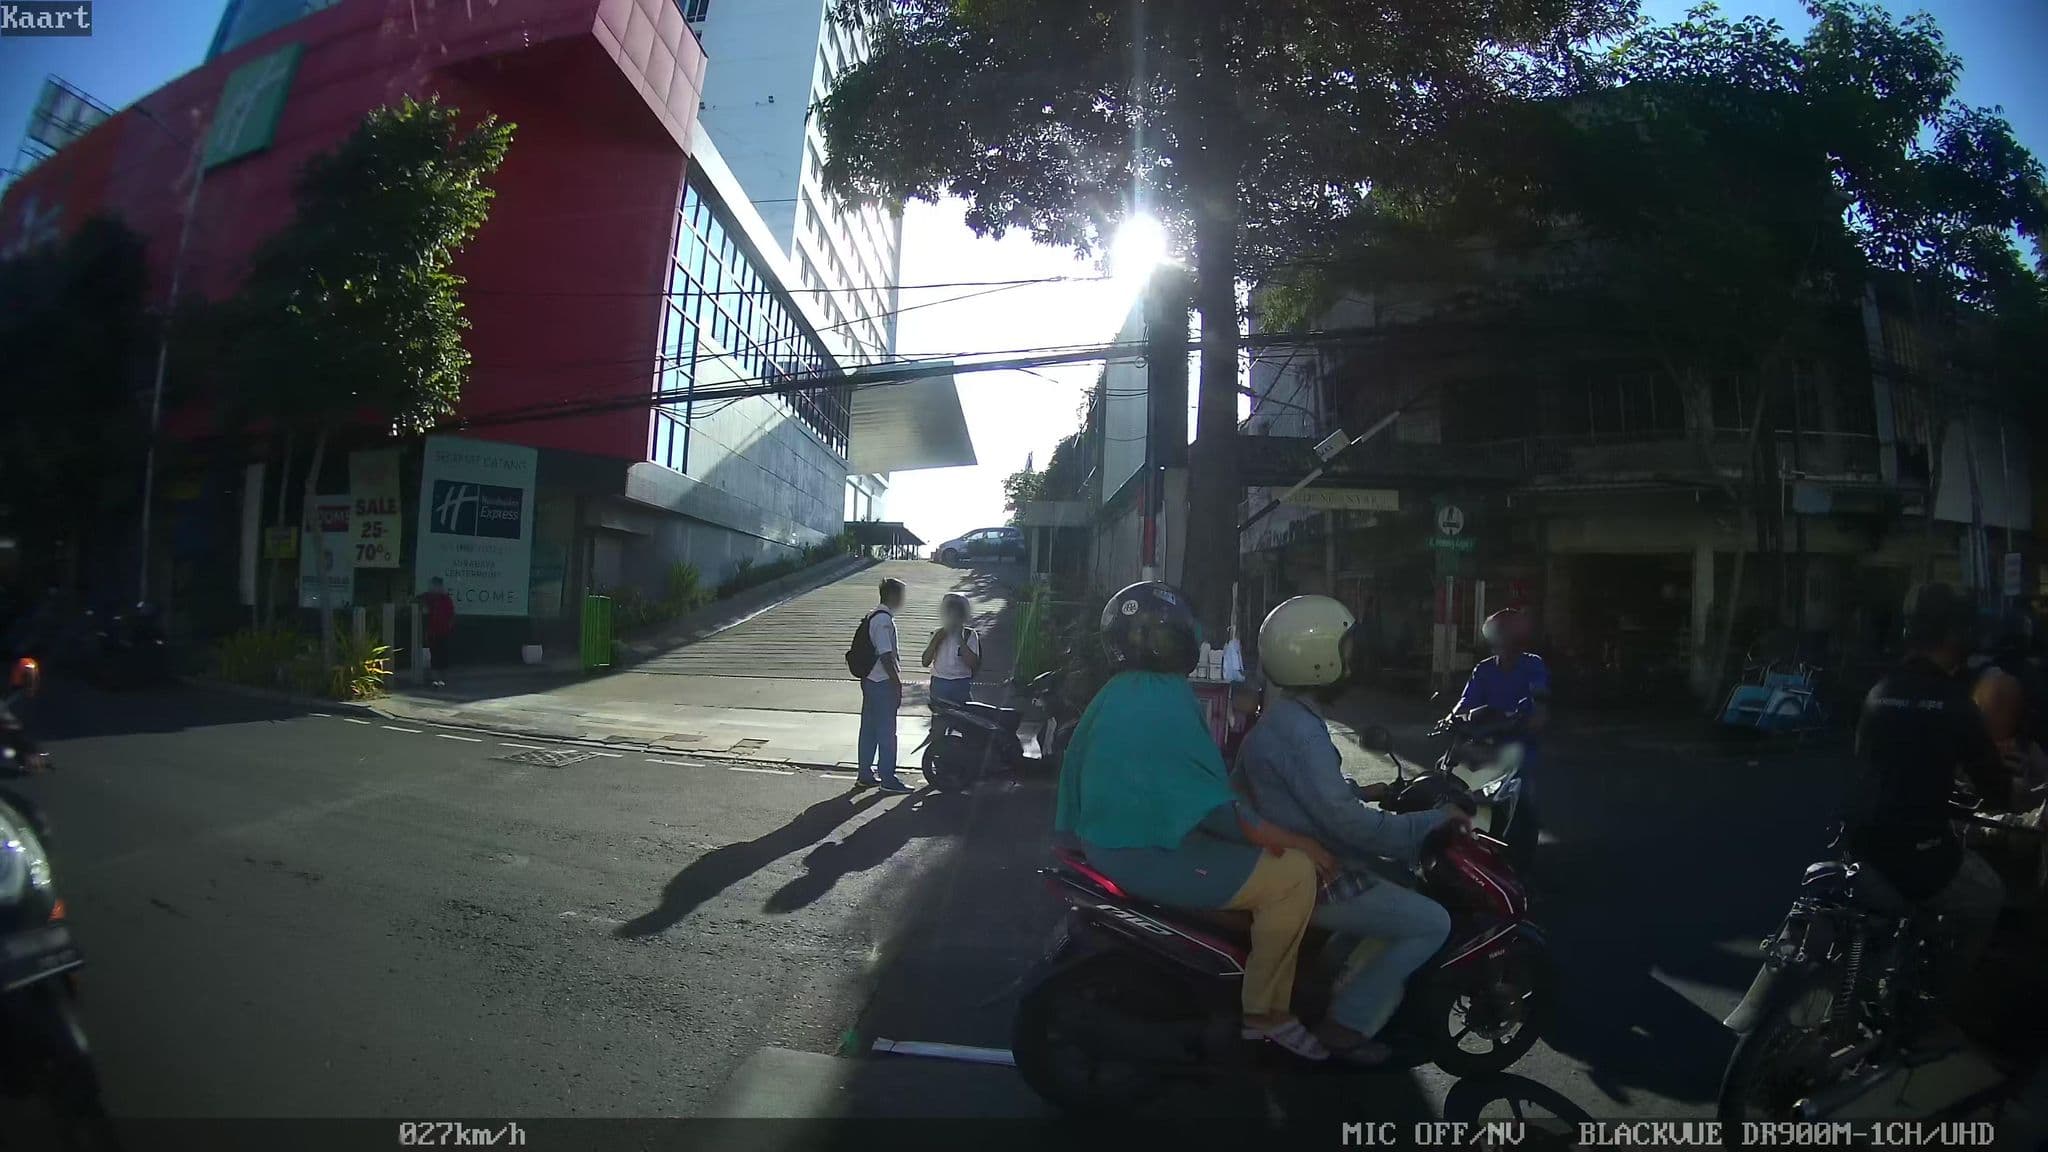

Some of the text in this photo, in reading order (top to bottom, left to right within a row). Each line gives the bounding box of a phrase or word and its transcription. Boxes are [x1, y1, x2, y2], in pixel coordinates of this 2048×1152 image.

[356, 497, 398, 516] SALE
[480, 506, 520, 521] Express
[447, 587, 517, 604] ELCOME
